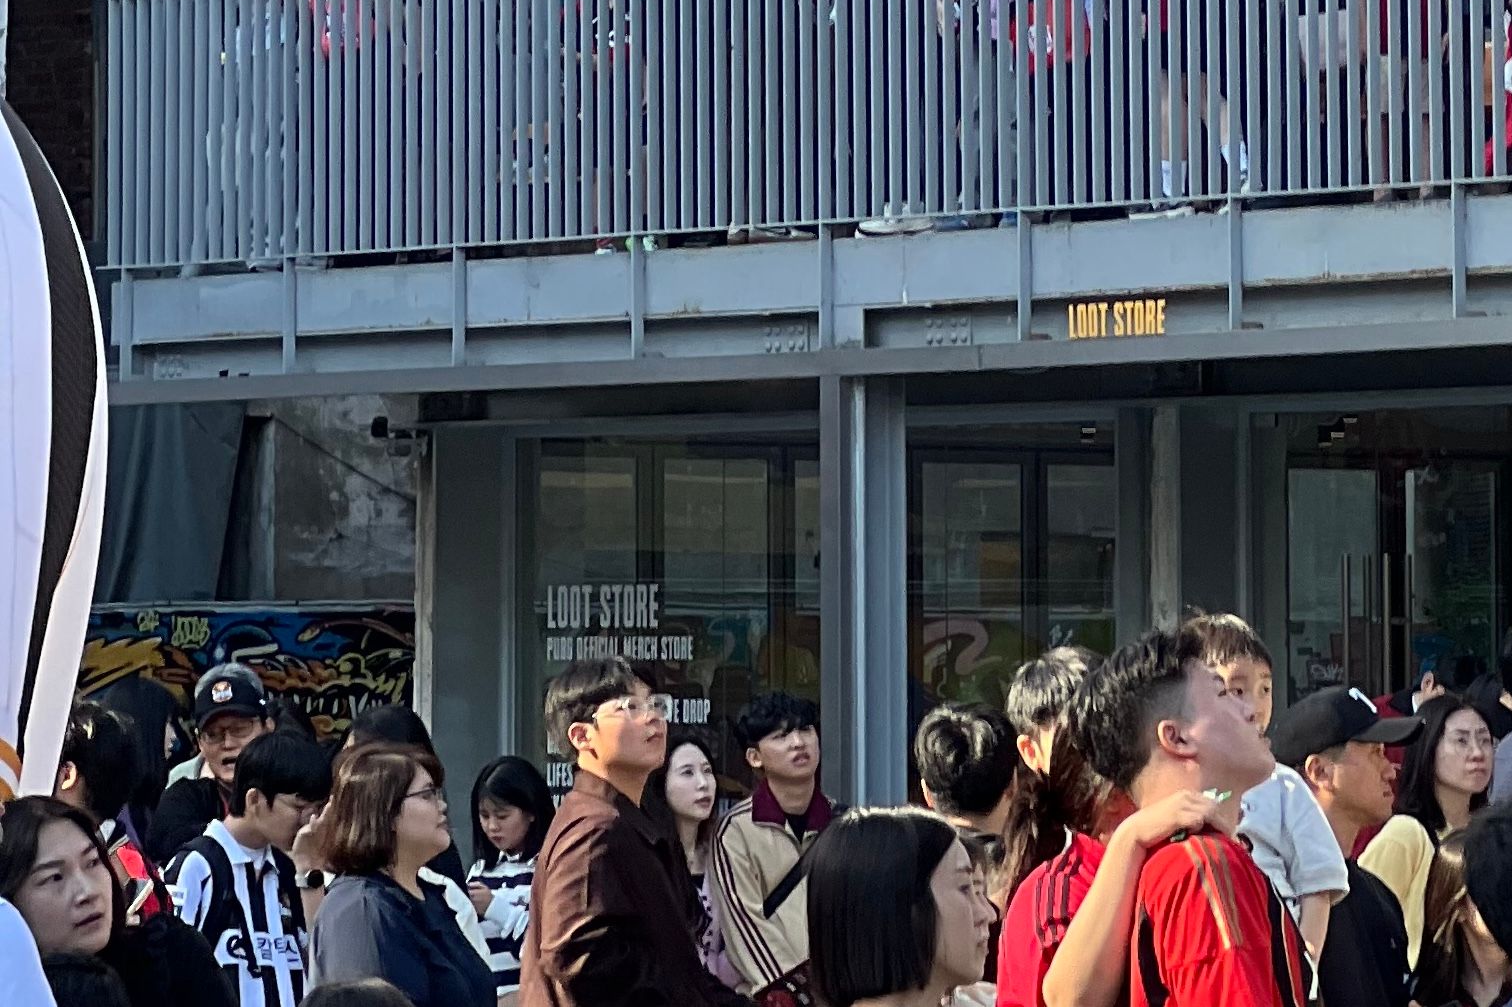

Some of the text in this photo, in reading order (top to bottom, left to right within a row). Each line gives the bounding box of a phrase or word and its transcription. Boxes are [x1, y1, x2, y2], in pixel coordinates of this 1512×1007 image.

[1068, 298, 1166, 340] LOOT STORE
[546, 583, 660, 630] LOOT STORE
[660, 635, 694, 661] STORE
[683, 697, 711, 724] DROP
